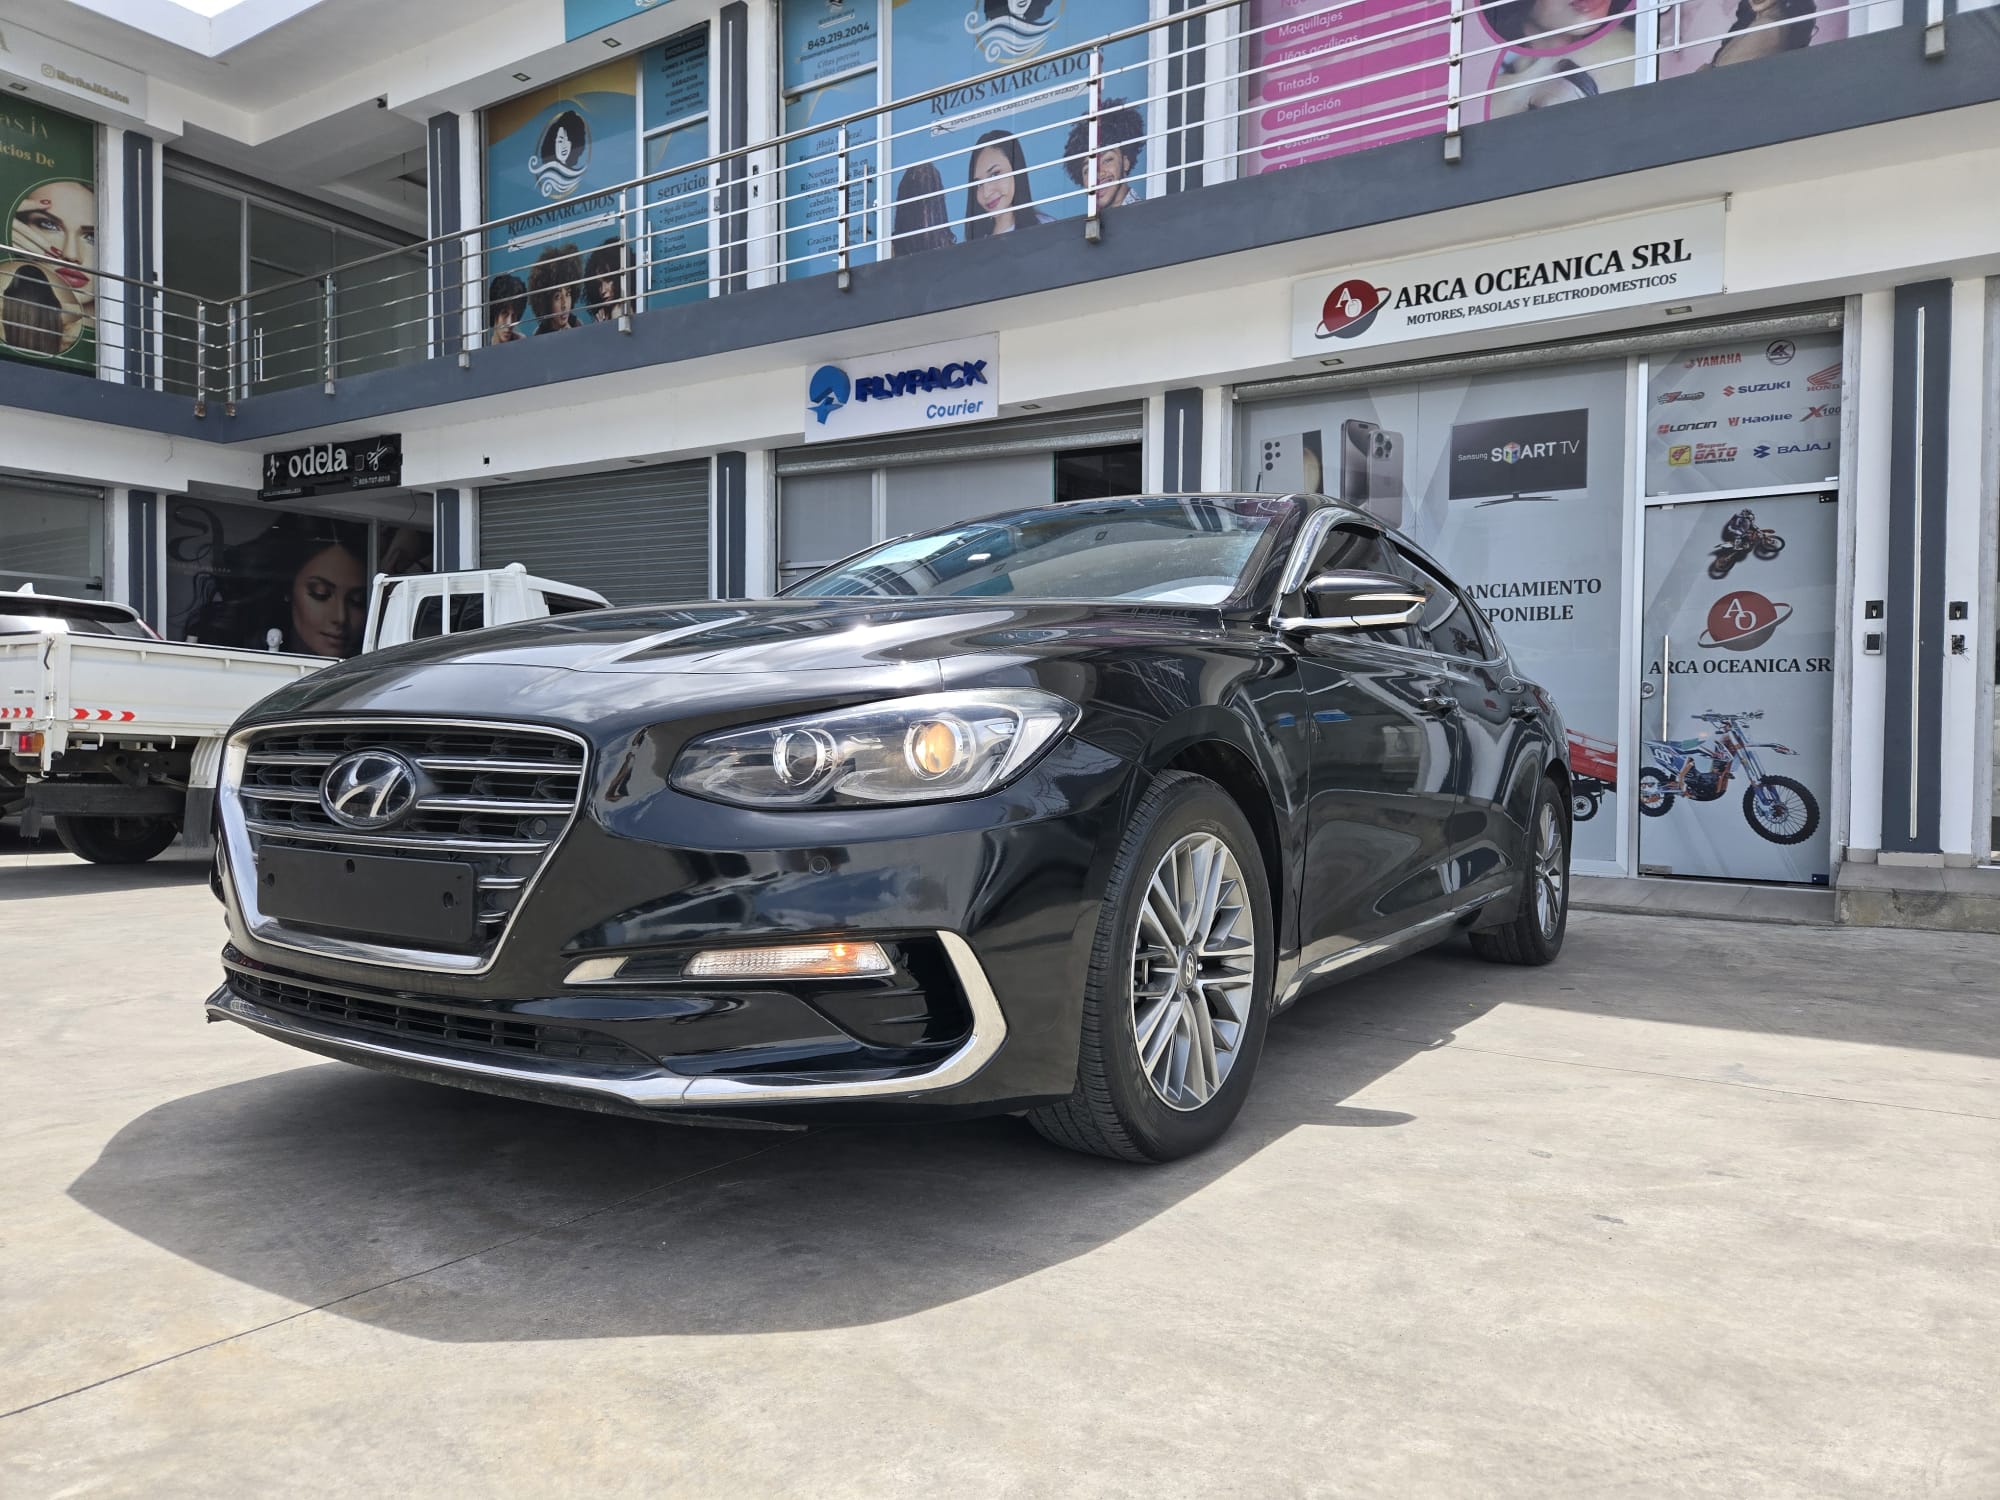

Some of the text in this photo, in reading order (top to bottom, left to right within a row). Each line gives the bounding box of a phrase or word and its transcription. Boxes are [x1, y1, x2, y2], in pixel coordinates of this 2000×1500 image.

[1279, 11, 1343, 37] Maquillajes
[807, 21, 870, 50] 849.219.2004
[1277, 73, 1320, 92] Tintado
[930, 82, 985, 115] RIZOS
[1277, 97, 1341, 123] Depilación
[35, 151, 55, 168] De
[508, 194, 616, 236] RIZOS MARCADOS
[1394, 238, 1692, 309] ARCA OCEANICA SRL
[1406, 272, 1677, 326] MOTORES, PASOLAS Y ELECTRODOMESTICOS
[1696, 352, 1742, 367] YAMAHA
[855, 359, 988, 402] FLYPACK
[1738, 381, 1790, 394] SUZUKI
[926, 399, 983, 419] Courier
[1742, 413, 1793, 425] Haojue
[1458, 453, 1488, 461] Samsung
[1560, 440, 1580, 454] TV
[1694, 447, 1738, 460] GATO
[1696, 442, 1727, 450] Super
[1777, 442, 1831, 454] BAJAJ
[1465, 578, 1602, 599] ANCIAMIENTO
[1648, 658, 1834, 675] ARCA OCEANICA SR
